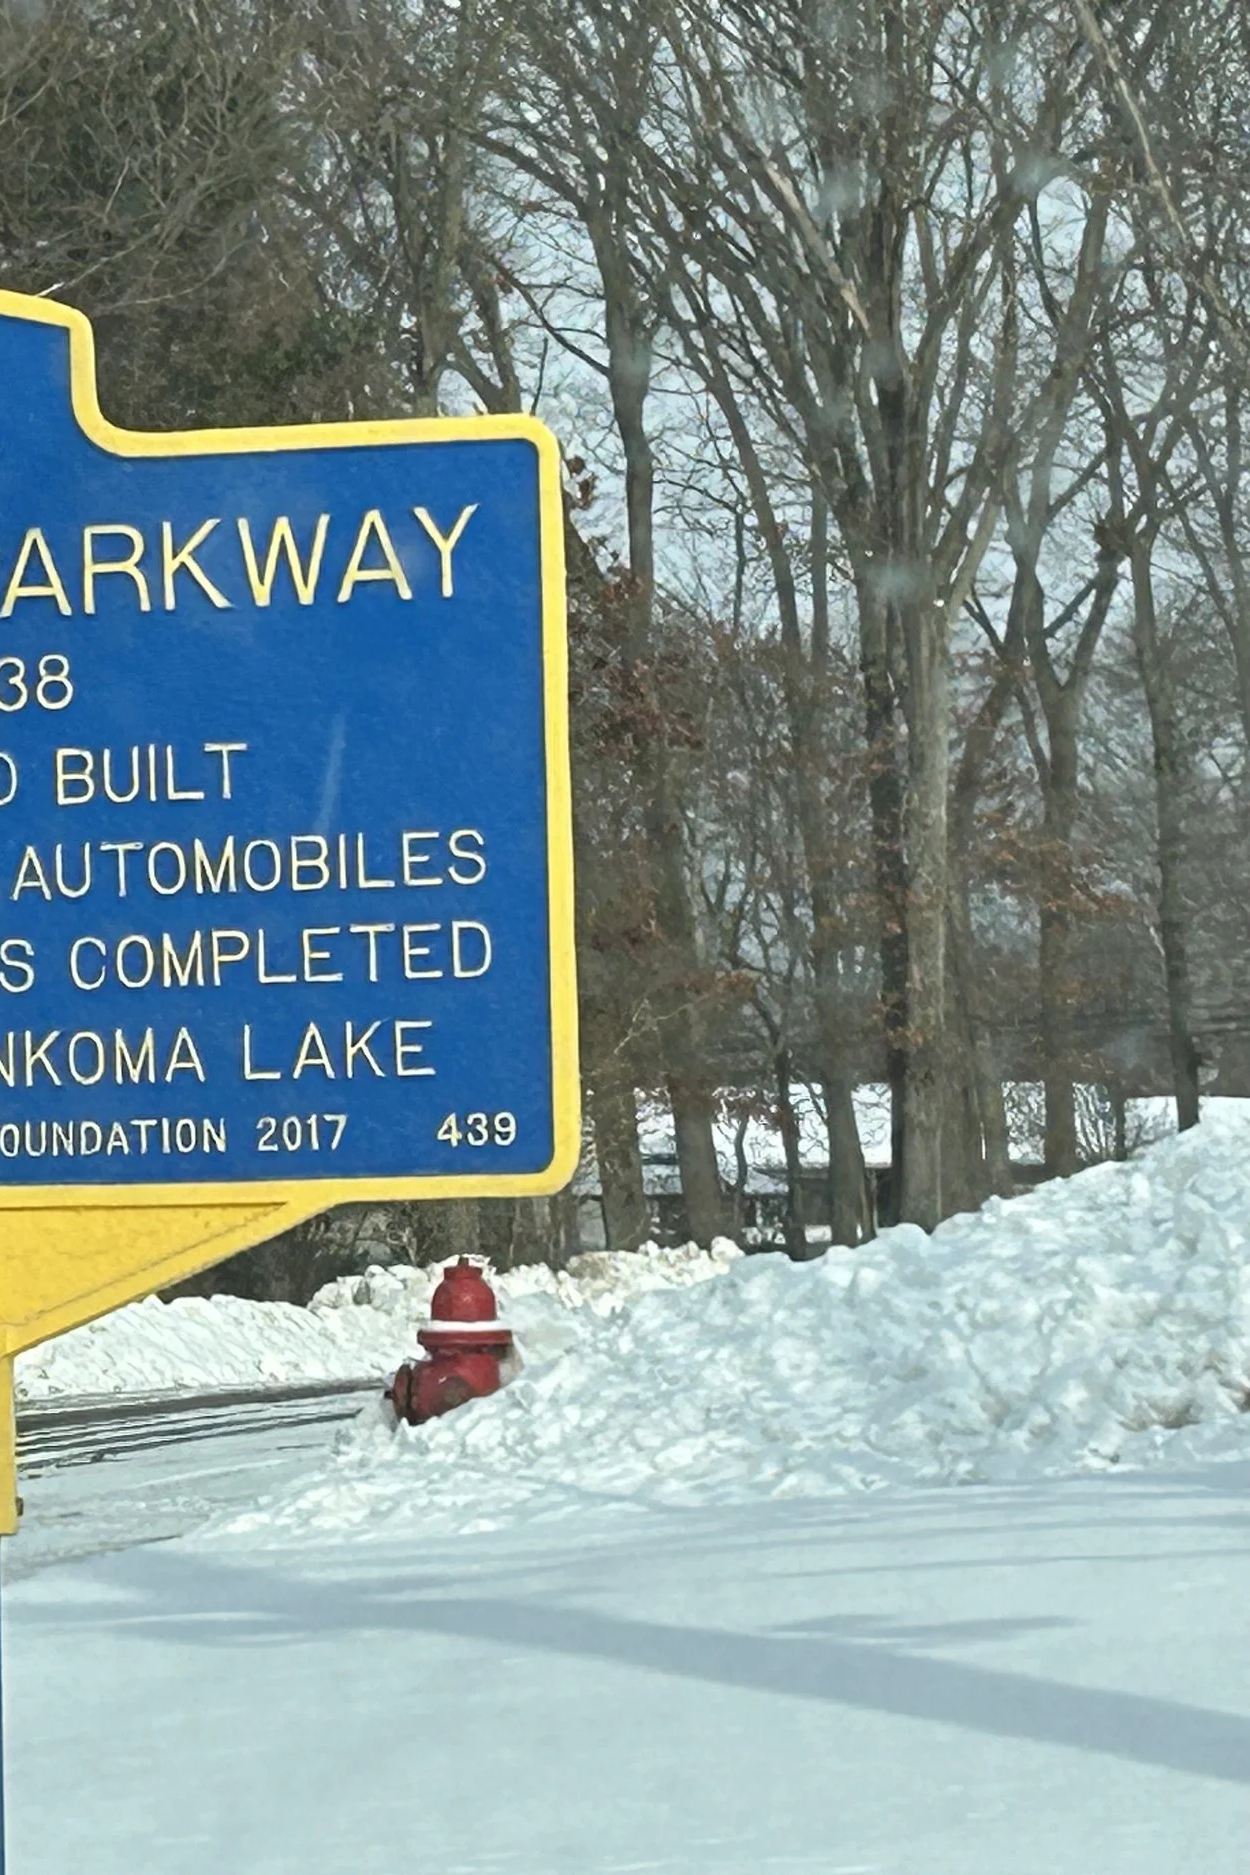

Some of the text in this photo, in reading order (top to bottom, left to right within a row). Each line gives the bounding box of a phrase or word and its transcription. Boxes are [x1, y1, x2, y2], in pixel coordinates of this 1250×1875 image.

[54, 741, 249, 807] BUILT
[11, 827, 488, 902] AUTOMOBILES
[69, 919, 493, 992] COMPLETED
[242, 1019, 437, 1082] LAKE
[255, 1112, 348, 1153] 2017
[435, 1110, 518, 1149] 439
